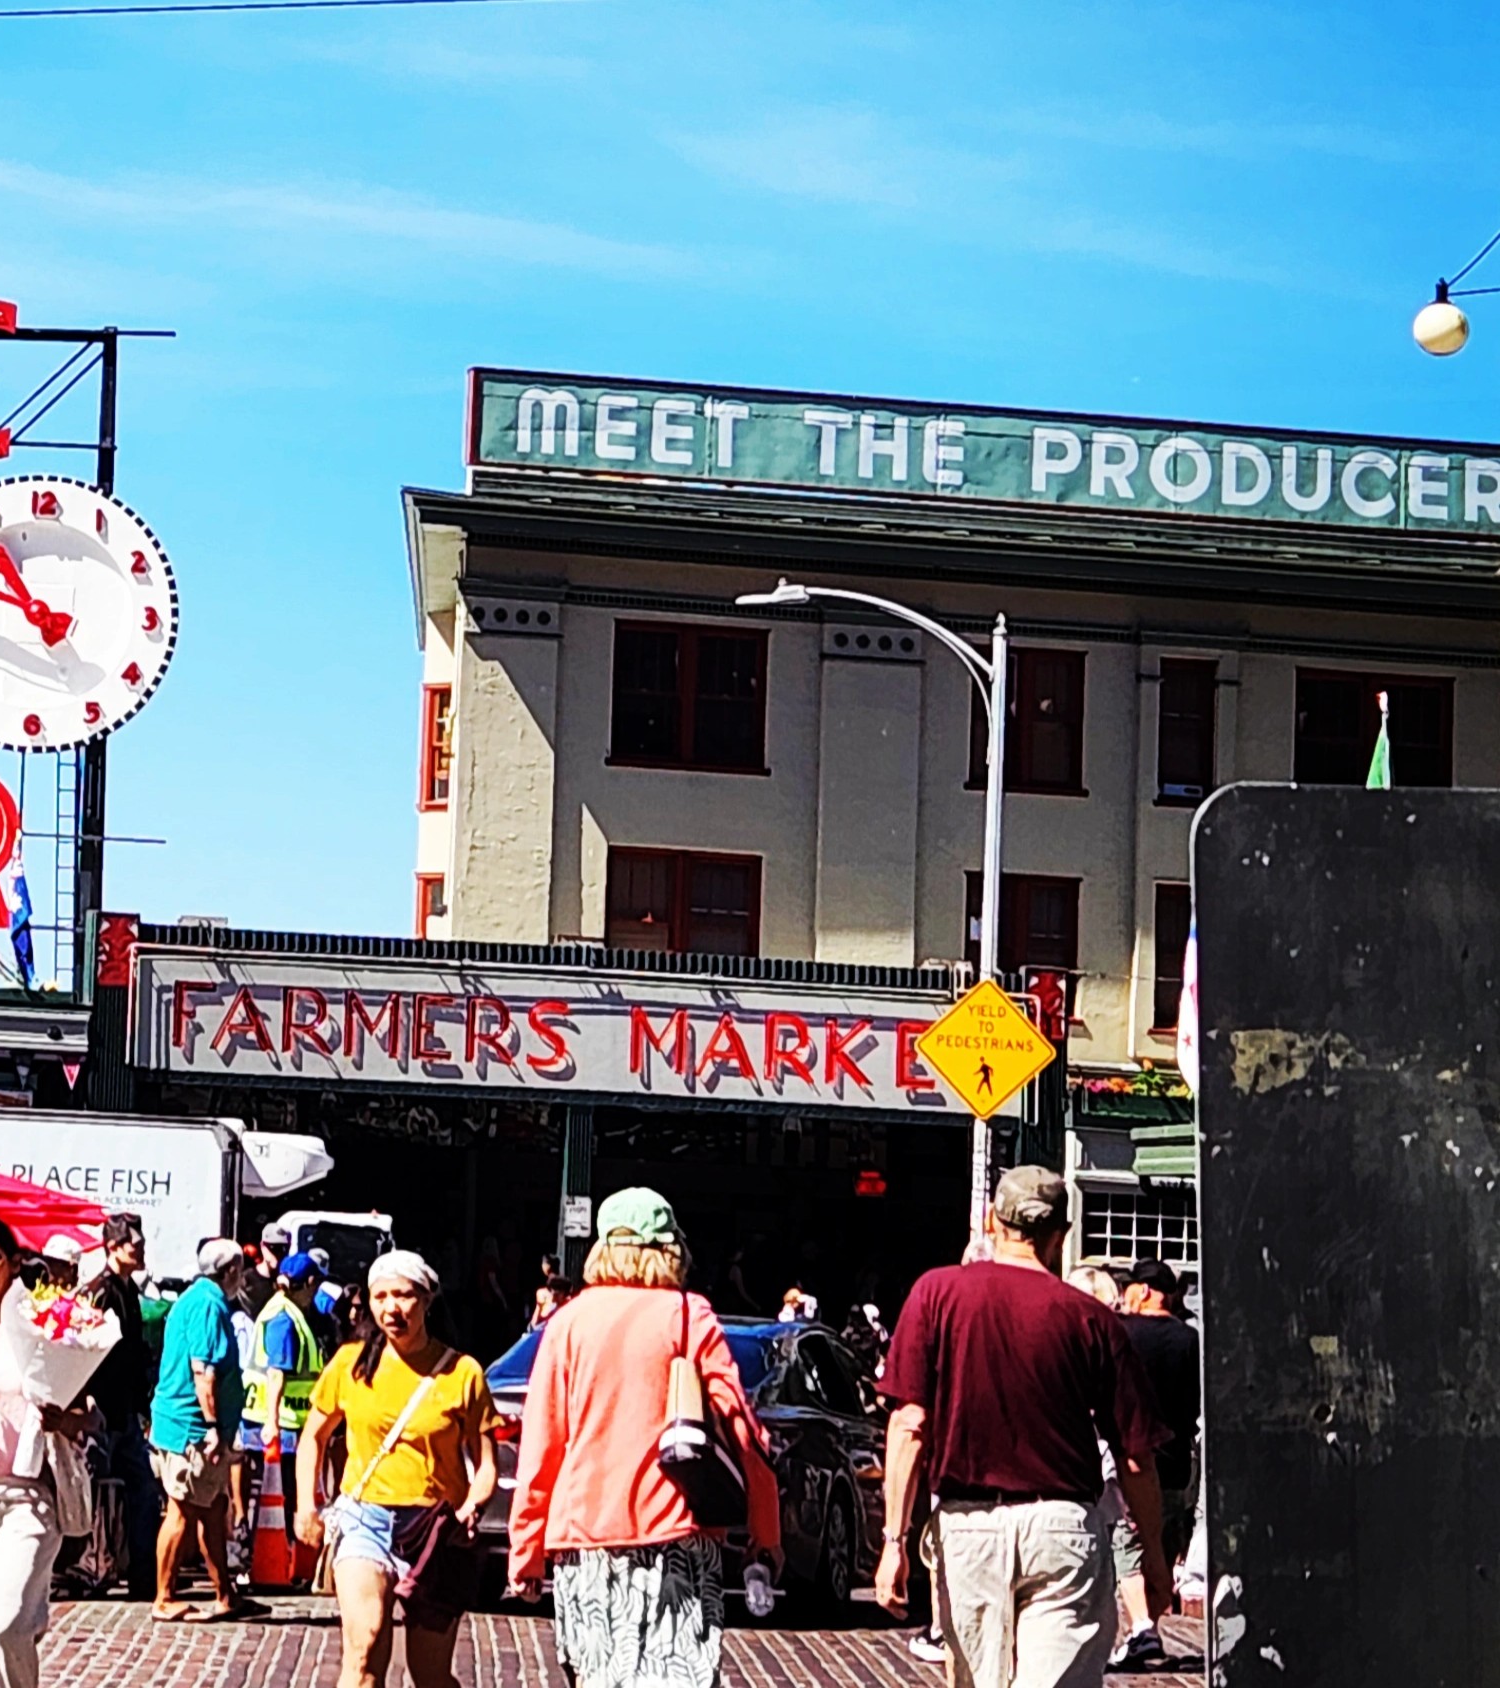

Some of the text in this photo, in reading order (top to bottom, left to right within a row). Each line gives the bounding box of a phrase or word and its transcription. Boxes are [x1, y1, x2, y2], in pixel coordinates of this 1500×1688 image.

[516, 388, 1500, 522] MEET THE PRODUCER
[32, 491, 57, 515] 12
[96, 509, 104, 533] 1
[131, 551, 146, 573] 2
[142, 607, 157, 631] 3
[121, 662, 139, 685] 4
[84, 702, 100, 724] 5
[23, 714, 41, 736] 6
[967, 1004, 1007, 1018] YIELD
[172, 980, 938, 1090] FARMERS MARKE
[978, 1020, 995, 1034] TO
[936, 1034, 1034, 1053] PEDESTRIANS
[11, 1163, 172, 1196] PLACE FISH
